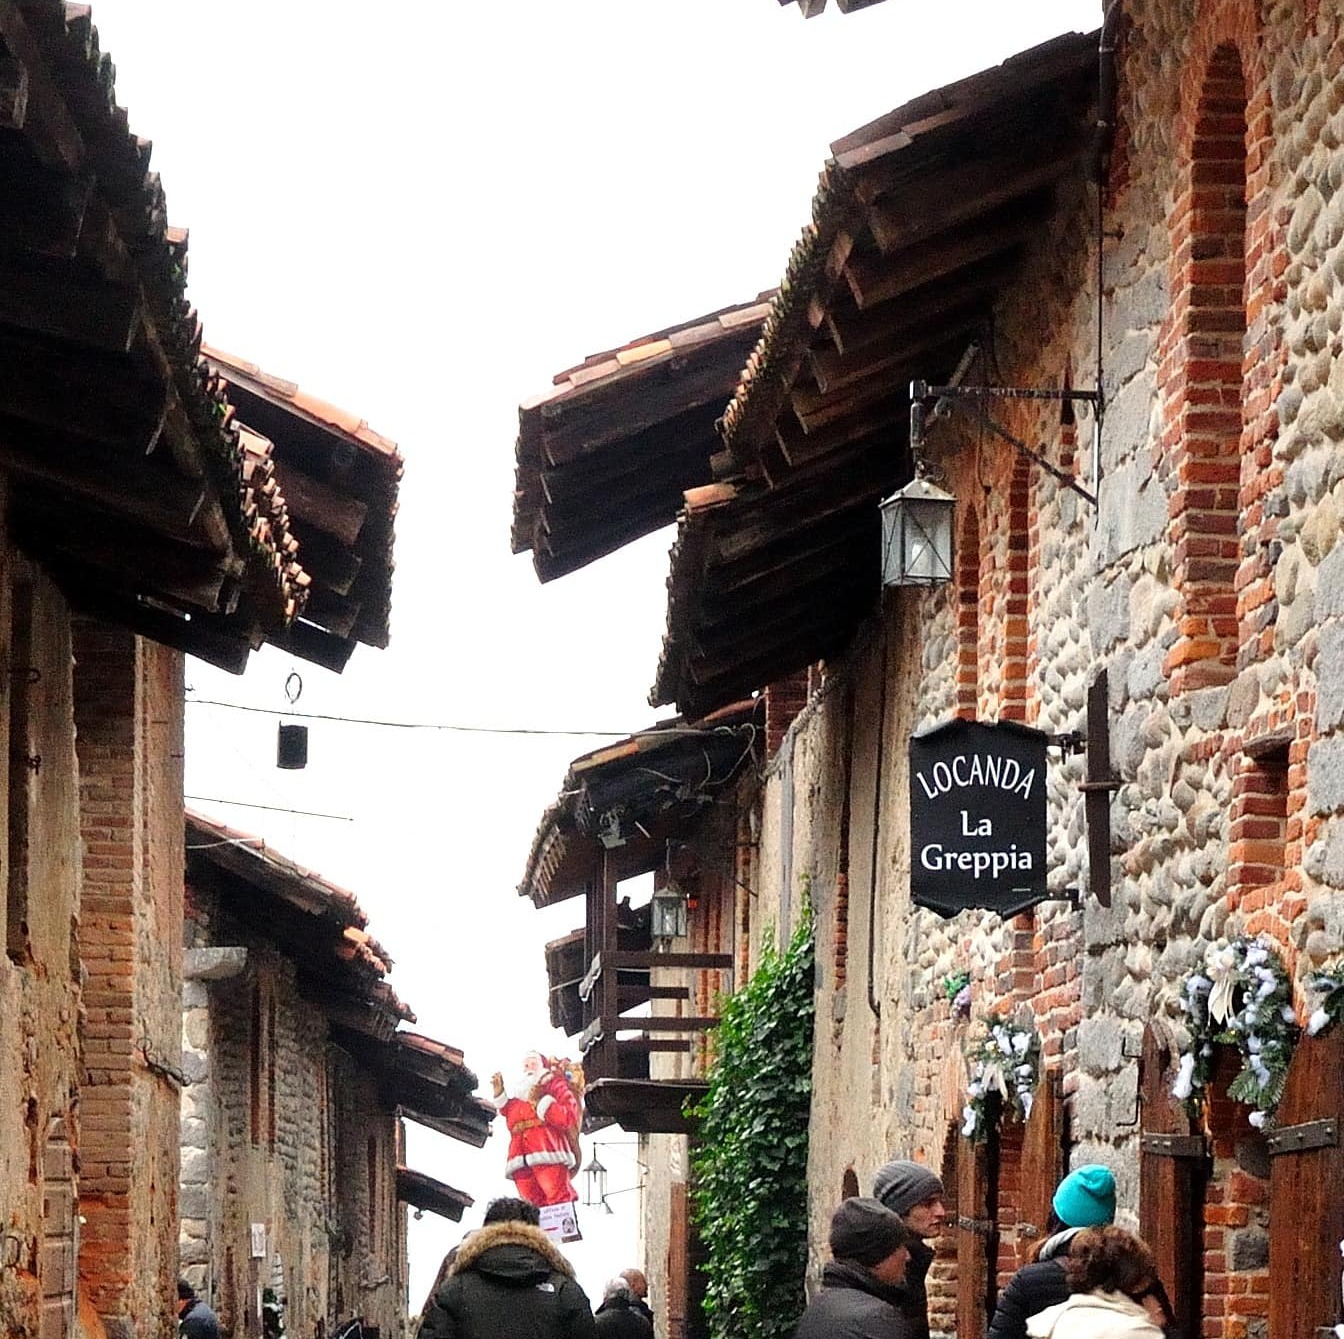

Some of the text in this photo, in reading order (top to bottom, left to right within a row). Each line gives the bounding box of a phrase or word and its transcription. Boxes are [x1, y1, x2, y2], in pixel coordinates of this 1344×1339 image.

[916, 754, 1036, 800] LOCANDA
[960, 810, 992, 837] La
[920, 843, 1033, 879] Greppia
